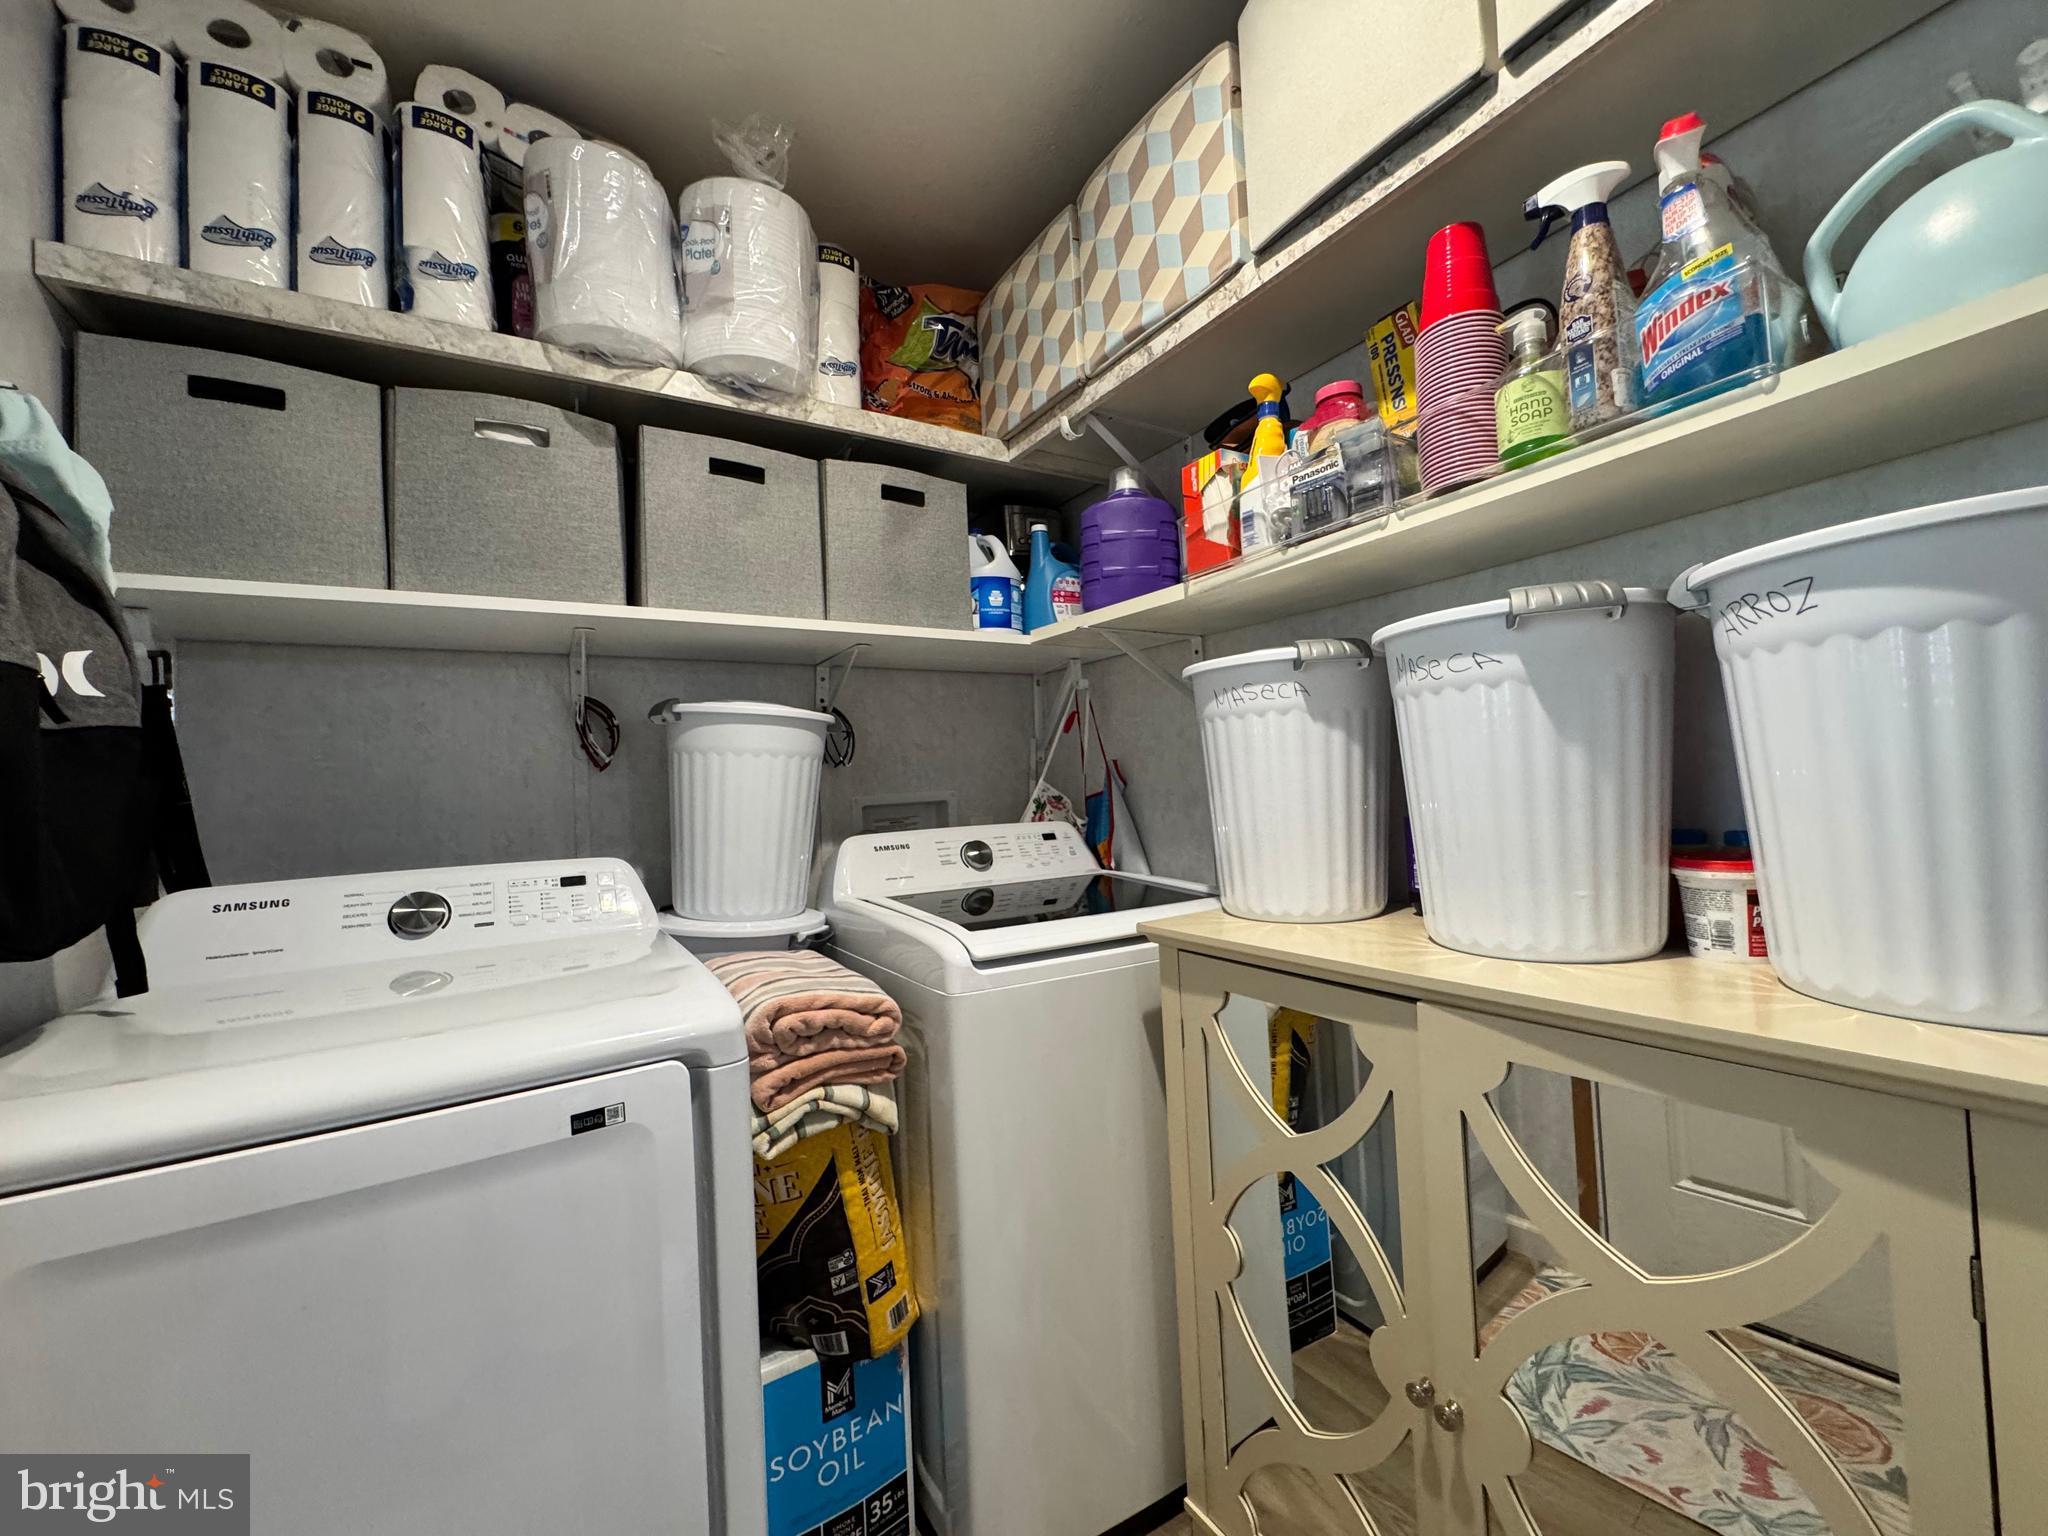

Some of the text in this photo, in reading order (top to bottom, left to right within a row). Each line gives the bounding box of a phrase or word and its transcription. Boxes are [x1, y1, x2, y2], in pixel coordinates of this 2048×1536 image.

[86, 39, 130, 57] LARGE
[92, 32, 130, 47] ROLLS
[209, 75, 249, 92] LARGE
[213, 68, 249, 84] ROLLS
[314, 102, 352, 119] LARGE
[319, 95, 352, 111] ROLLS
[420, 118, 453, 134] LARGE
[424, 112, 454, 126] ROLLS
[75, 193, 157, 218] BathTissue
[203, 225, 276, 249] BathTissue
[310, 246, 375, 268] BathTissue
[418, 259, 477, 281] BathTissue
[1395, 311, 1415, 344] GLAD
[1640, 279, 1735, 368] Windex
[1381, 332, 1407, 412] PRESS'NS
[1661, 347, 1704, 380] ORIGINAL
[1509, 397, 1553, 417] HAND
[1511, 407, 1553, 428] SOAP
[1291, 460, 1340, 485] Panasonic
[1718, 577, 1818, 640] ARROZ
[873, 843, 911, 852] SAMSUNG
[211, 898, 291, 914] SAMSUNG
[770, 1393, 902, 1482] SOYBEAN
[818, 1448, 865, 1486] OIL
[870, 1491, 893, 1523] 35
